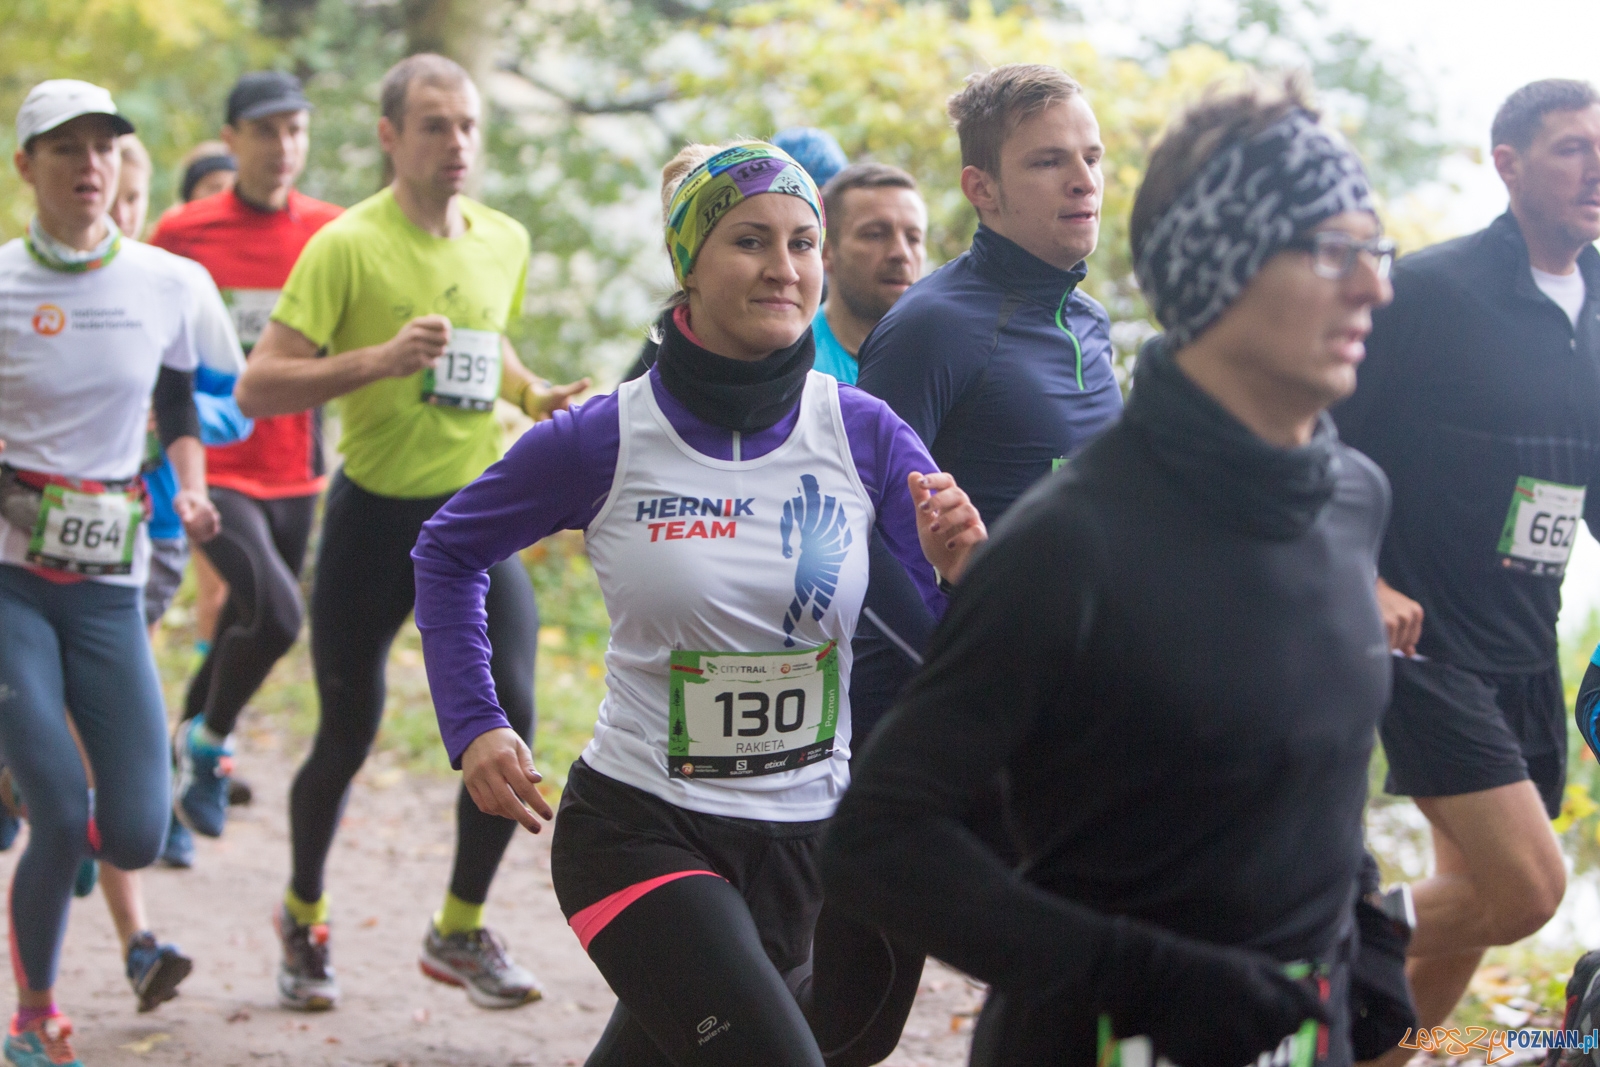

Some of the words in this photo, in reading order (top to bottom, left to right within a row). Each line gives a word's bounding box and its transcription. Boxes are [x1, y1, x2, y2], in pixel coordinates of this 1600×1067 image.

[636, 496, 756, 522] HERNIK
[59, 517, 120, 549] 864
[647, 520, 737, 543] TEAM
[714, 688, 806, 738] 130
[736, 739, 785, 754] RAKIETA
